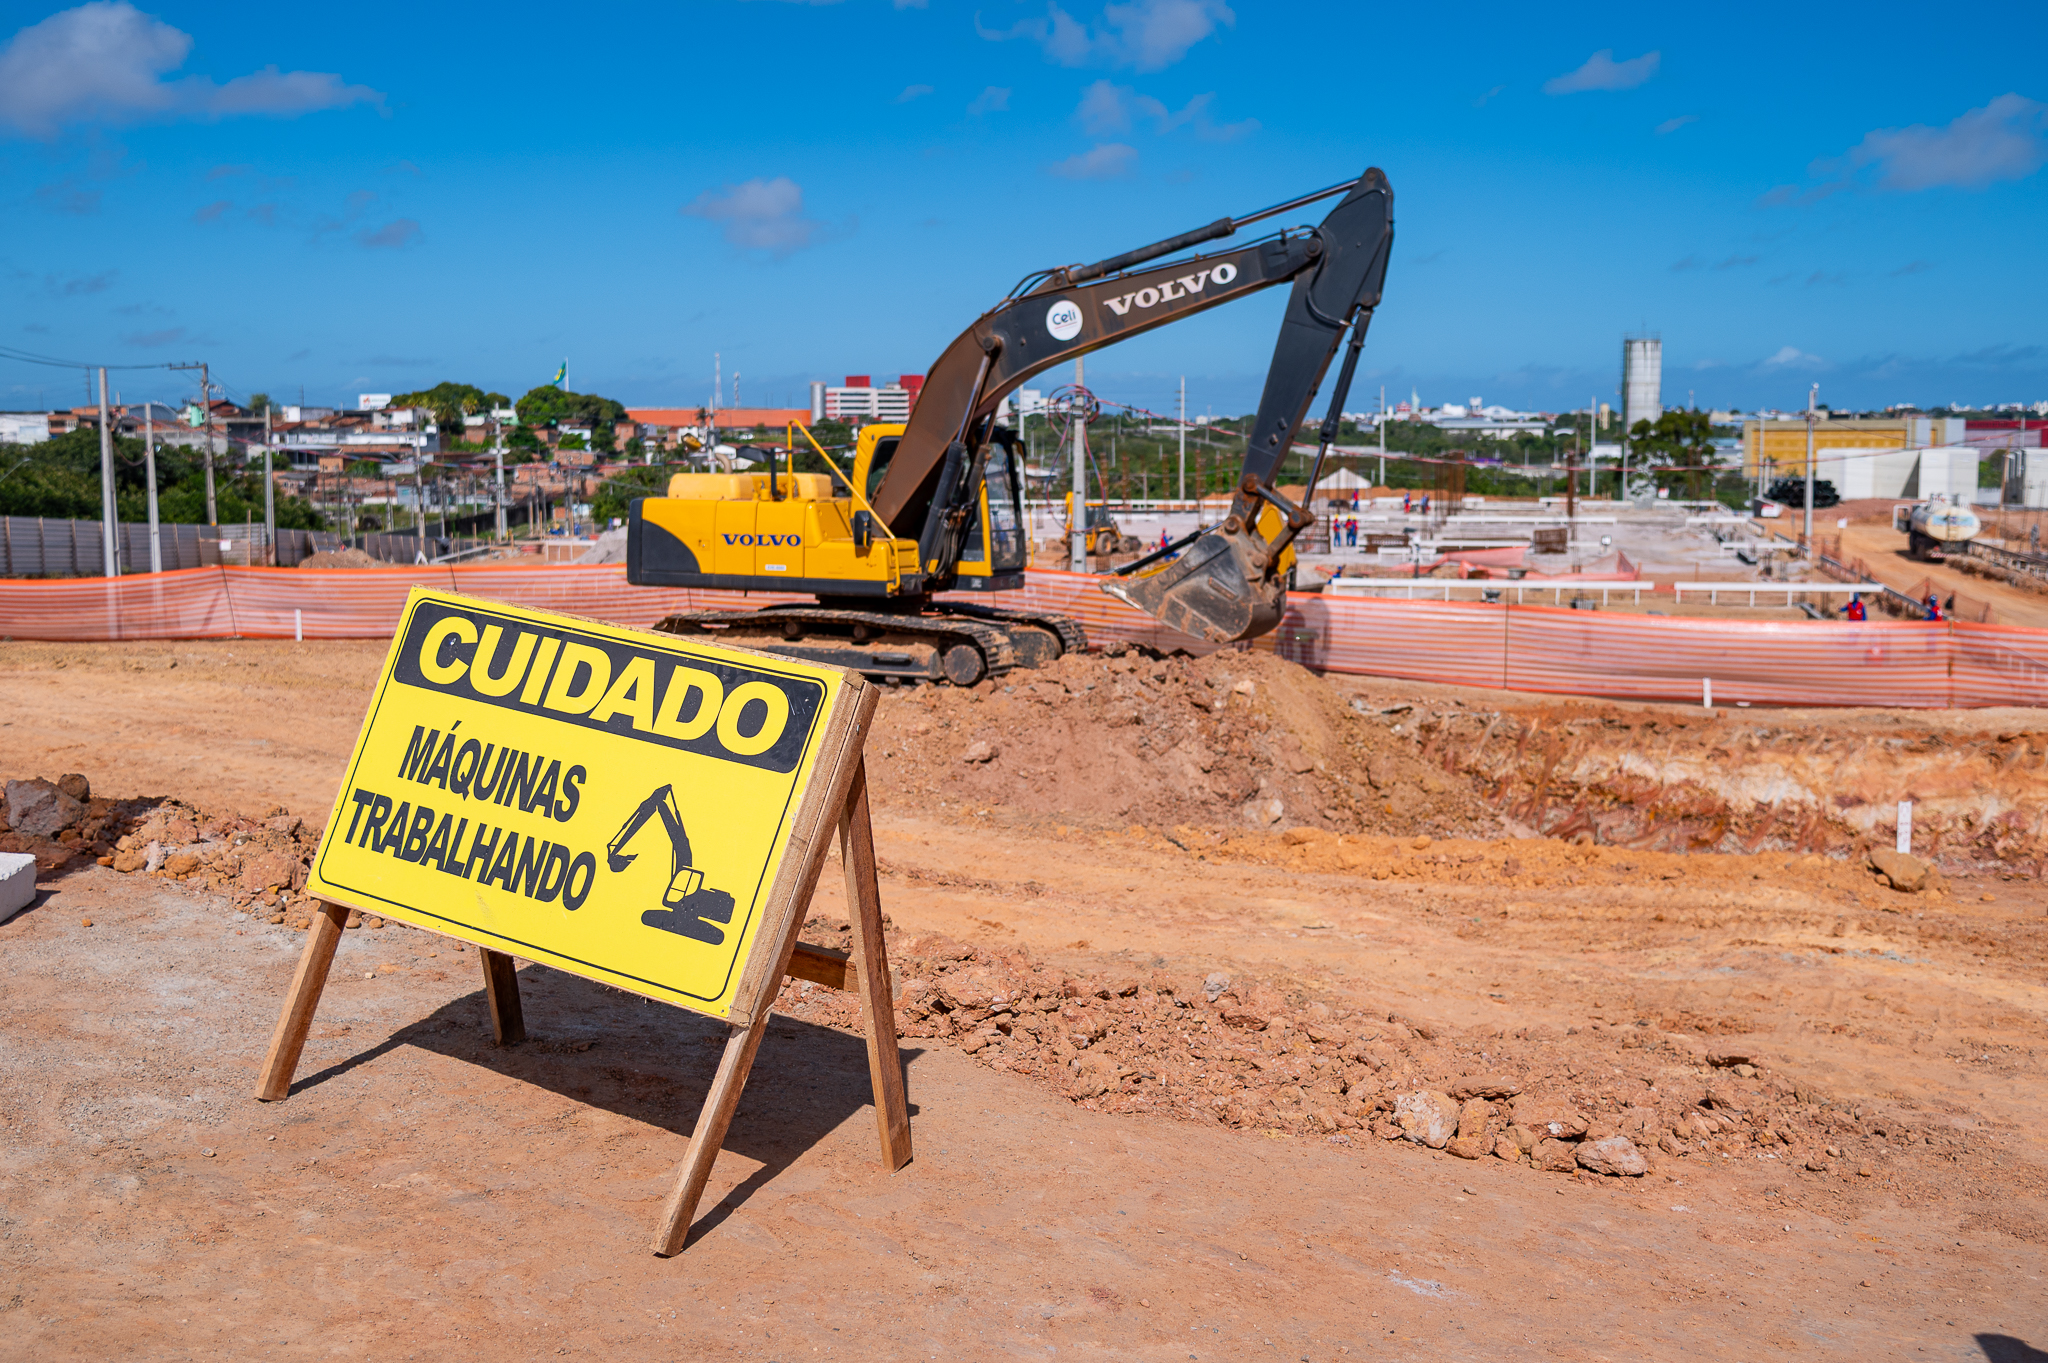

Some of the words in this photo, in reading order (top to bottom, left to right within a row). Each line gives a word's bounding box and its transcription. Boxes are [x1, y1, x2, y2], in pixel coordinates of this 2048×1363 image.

[1052, 309, 1076, 325] Celi
[1103, 263, 1237, 315] VOLVO
[721, 533, 801, 547] VOLVO
[419, 617, 789, 756] CUIDADO
[397, 720, 586, 822] MÁQUINAS
[344, 788, 596, 911] TRABALHANDO
